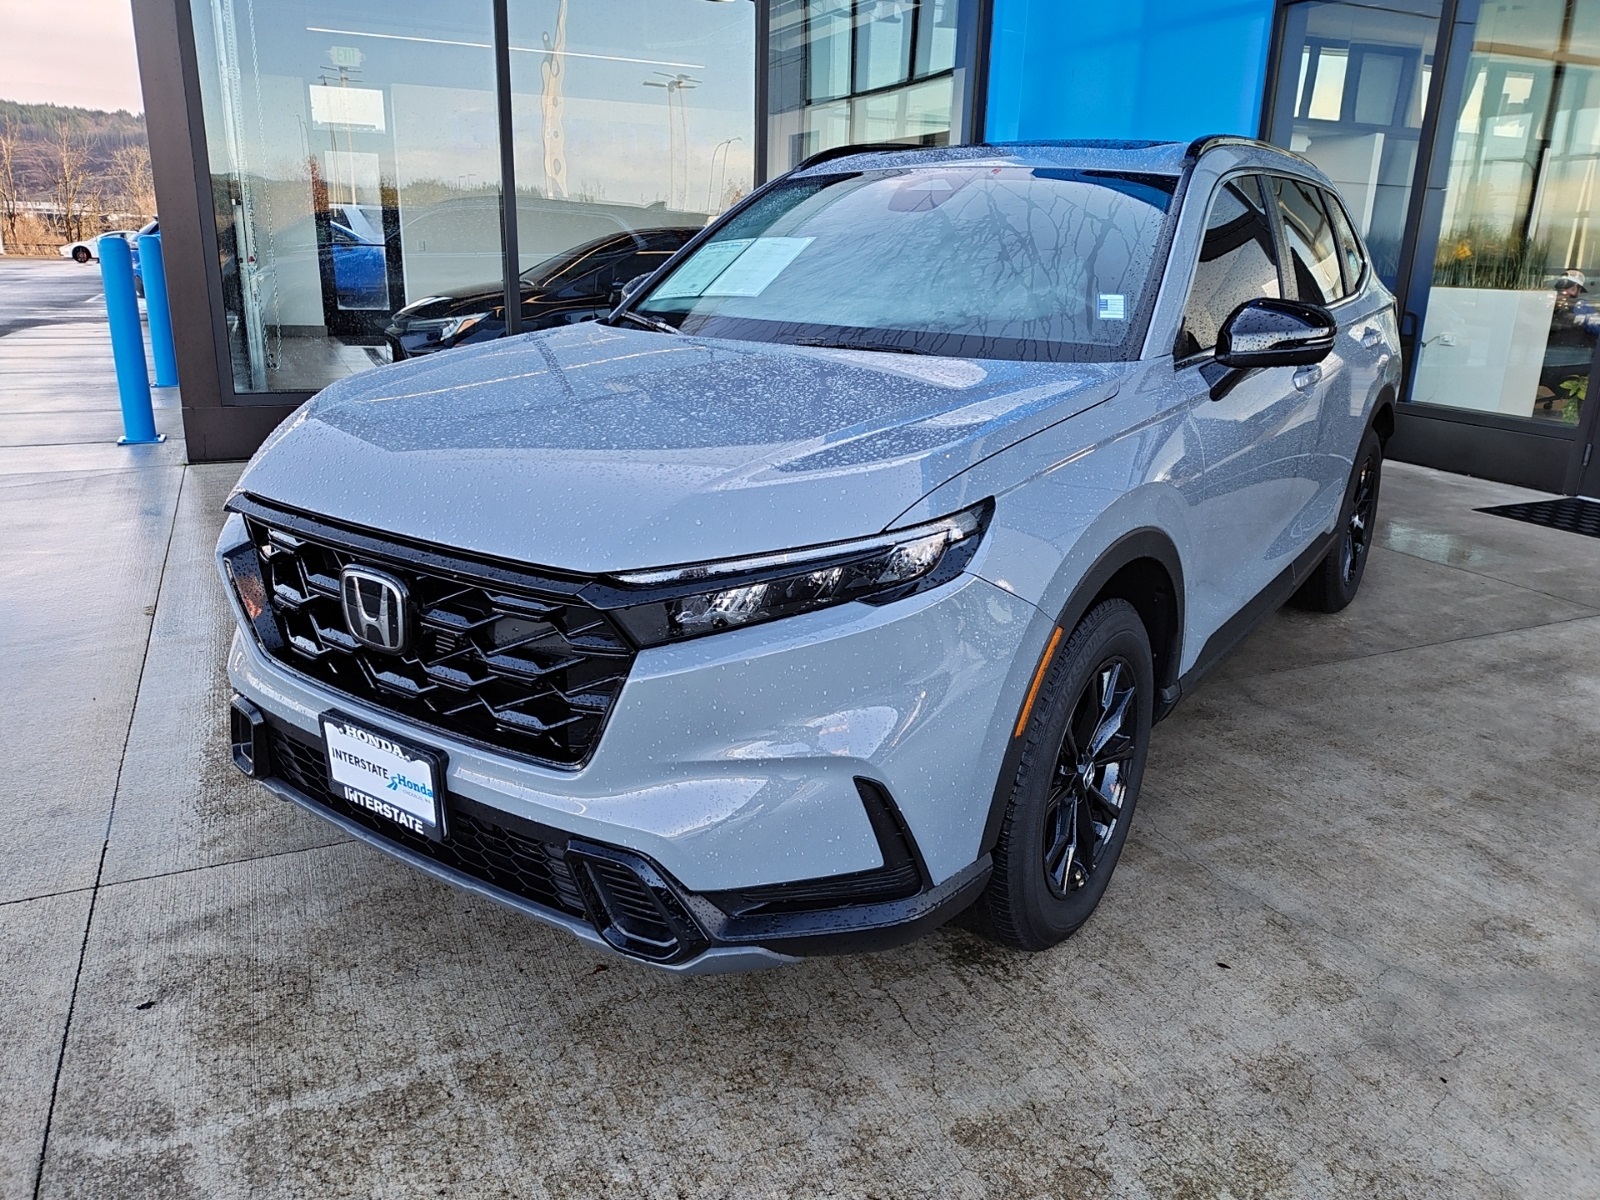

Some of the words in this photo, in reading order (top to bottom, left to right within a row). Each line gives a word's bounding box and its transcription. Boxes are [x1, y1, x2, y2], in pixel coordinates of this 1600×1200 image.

[343, 724, 404, 759] HONDA
[332, 747, 389, 779] INTERSTATE
[396, 773, 434, 798] Honda
[344, 786, 424, 834] INTERSTATE
